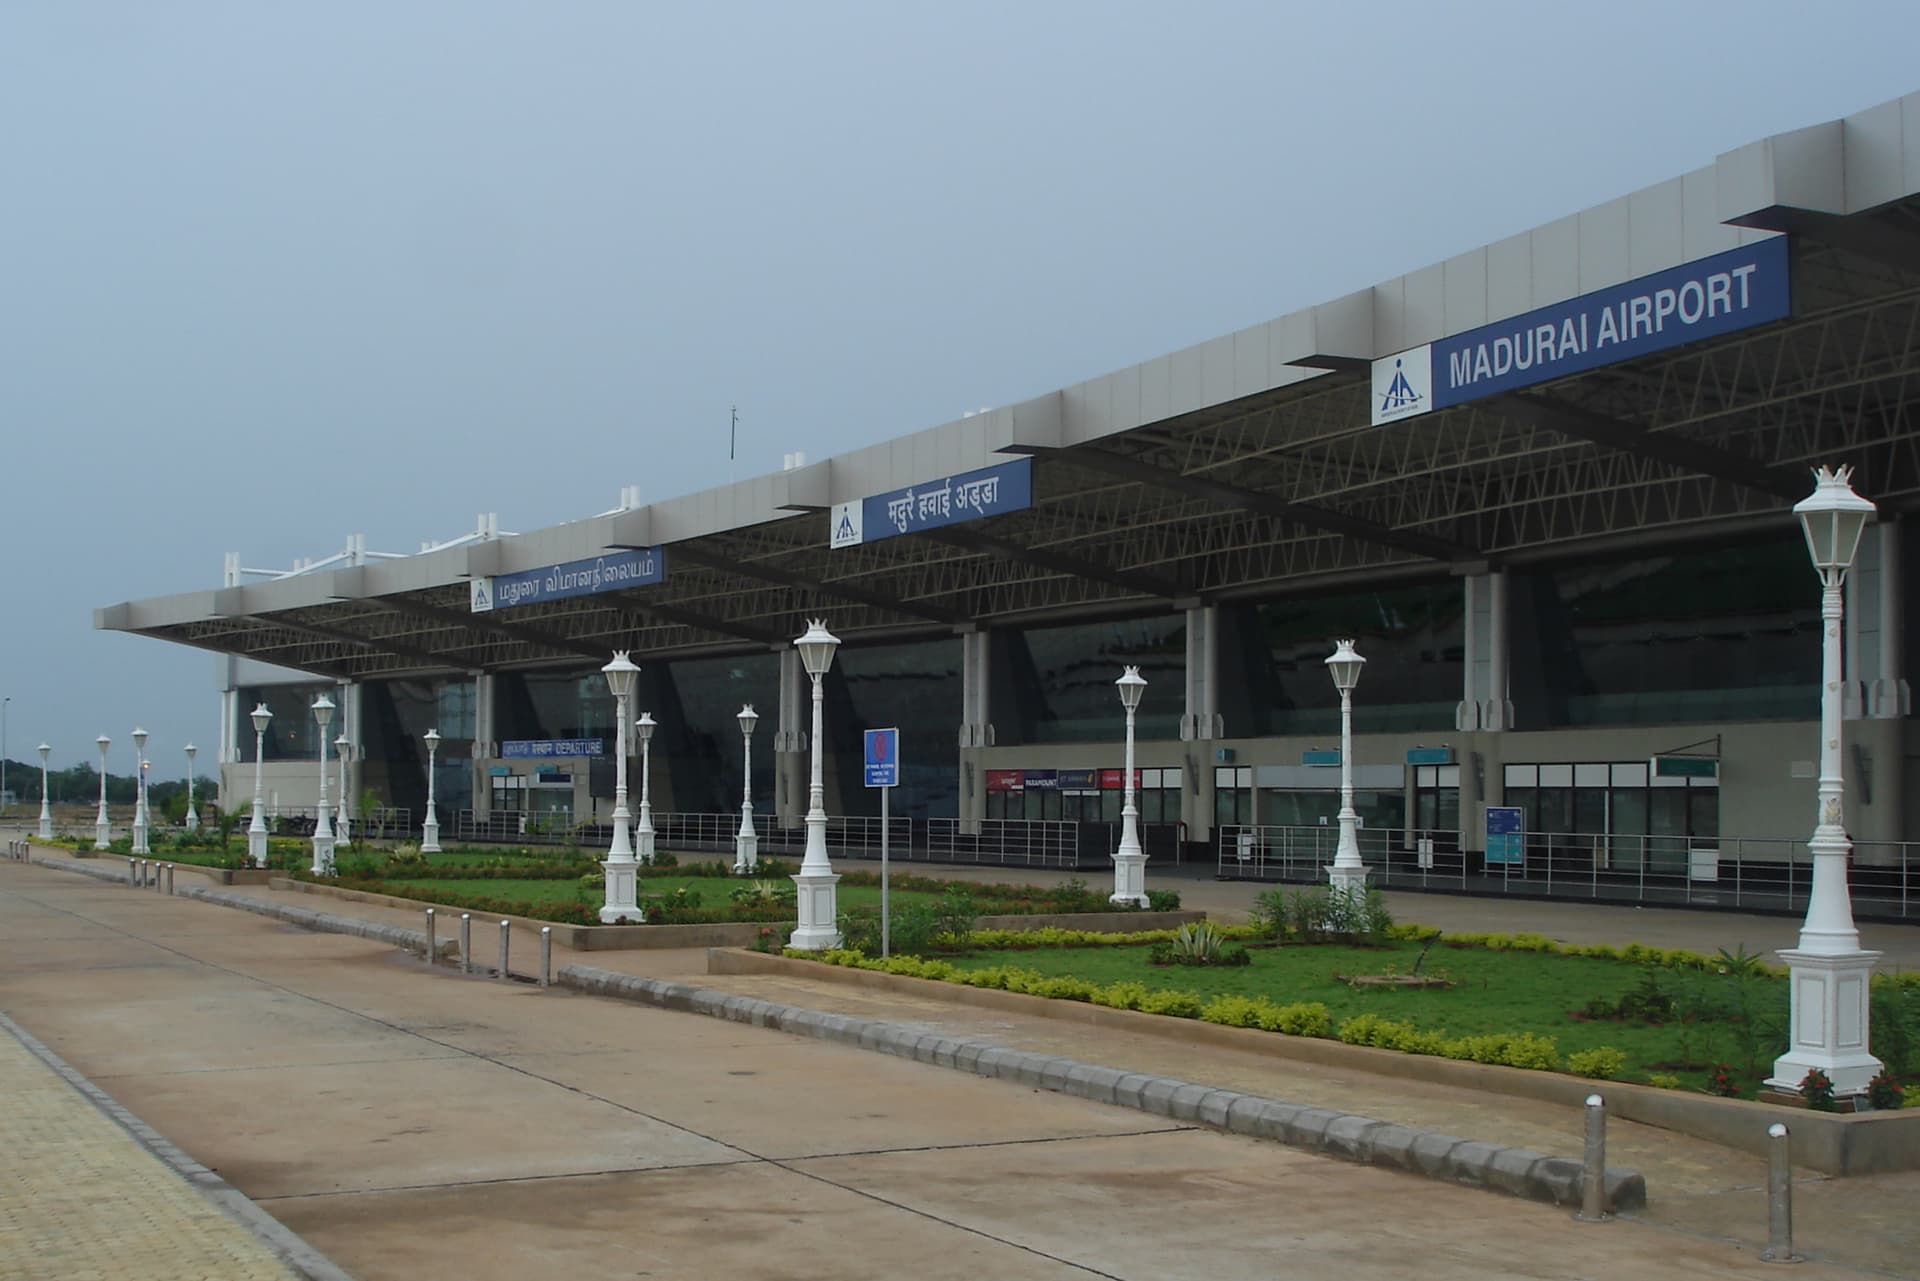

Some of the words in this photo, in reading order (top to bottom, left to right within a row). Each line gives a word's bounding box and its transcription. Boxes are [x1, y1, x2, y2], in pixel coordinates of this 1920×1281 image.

[1450, 313, 1588, 389] MADURAI
[1597, 264, 1757, 349] AIRPORT
[888, 488, 915, 533] मदुरै
[918, 478, 951, 520] हवाई
[500, 578, 540, 605] மதுரை
[545, 551, 654, 592] விமானநிலையம்
[555, 741, 601, 755] DEPARTURE
[1025, 778, 1057, 787] PARAMOUNT
